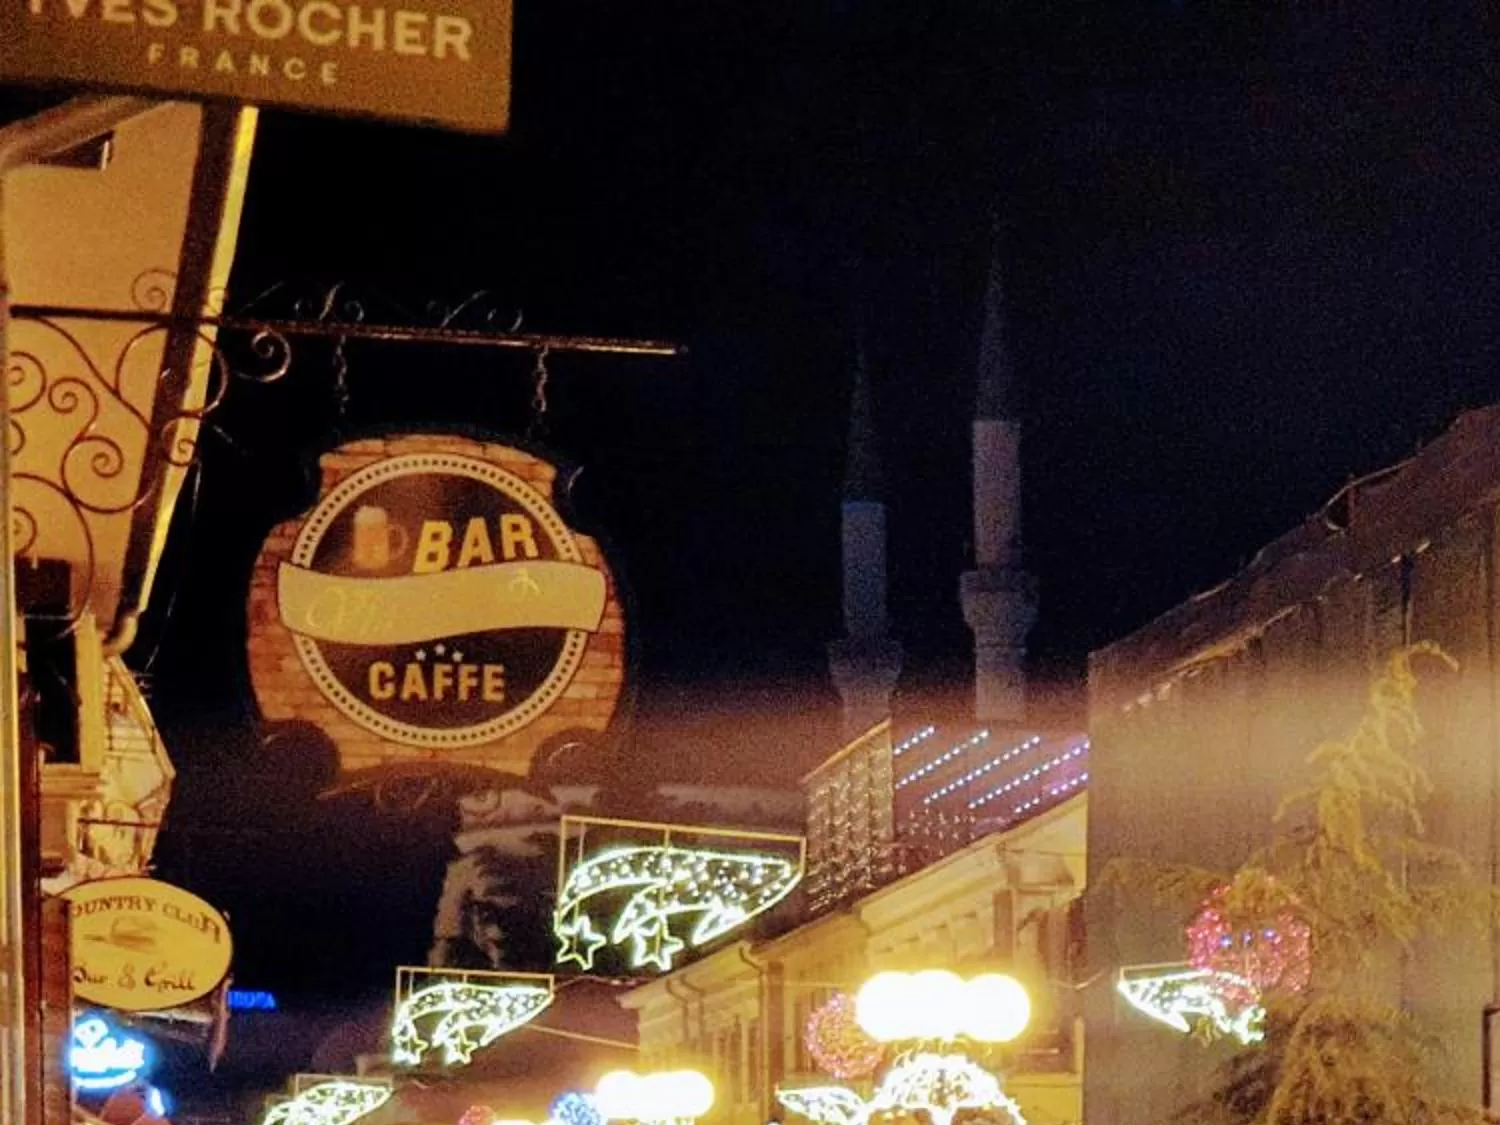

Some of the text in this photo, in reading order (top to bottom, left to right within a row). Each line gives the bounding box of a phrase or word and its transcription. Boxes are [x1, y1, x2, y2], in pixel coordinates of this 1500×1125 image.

[203, 0, 472, 59] ROCHER
[149, 43, 339, 84] FRANCE
[413, 513, 539, 574] BAR
[368, 660, 506, 701] CAFFE
[71, 895, 157, 918] OUNTRY
